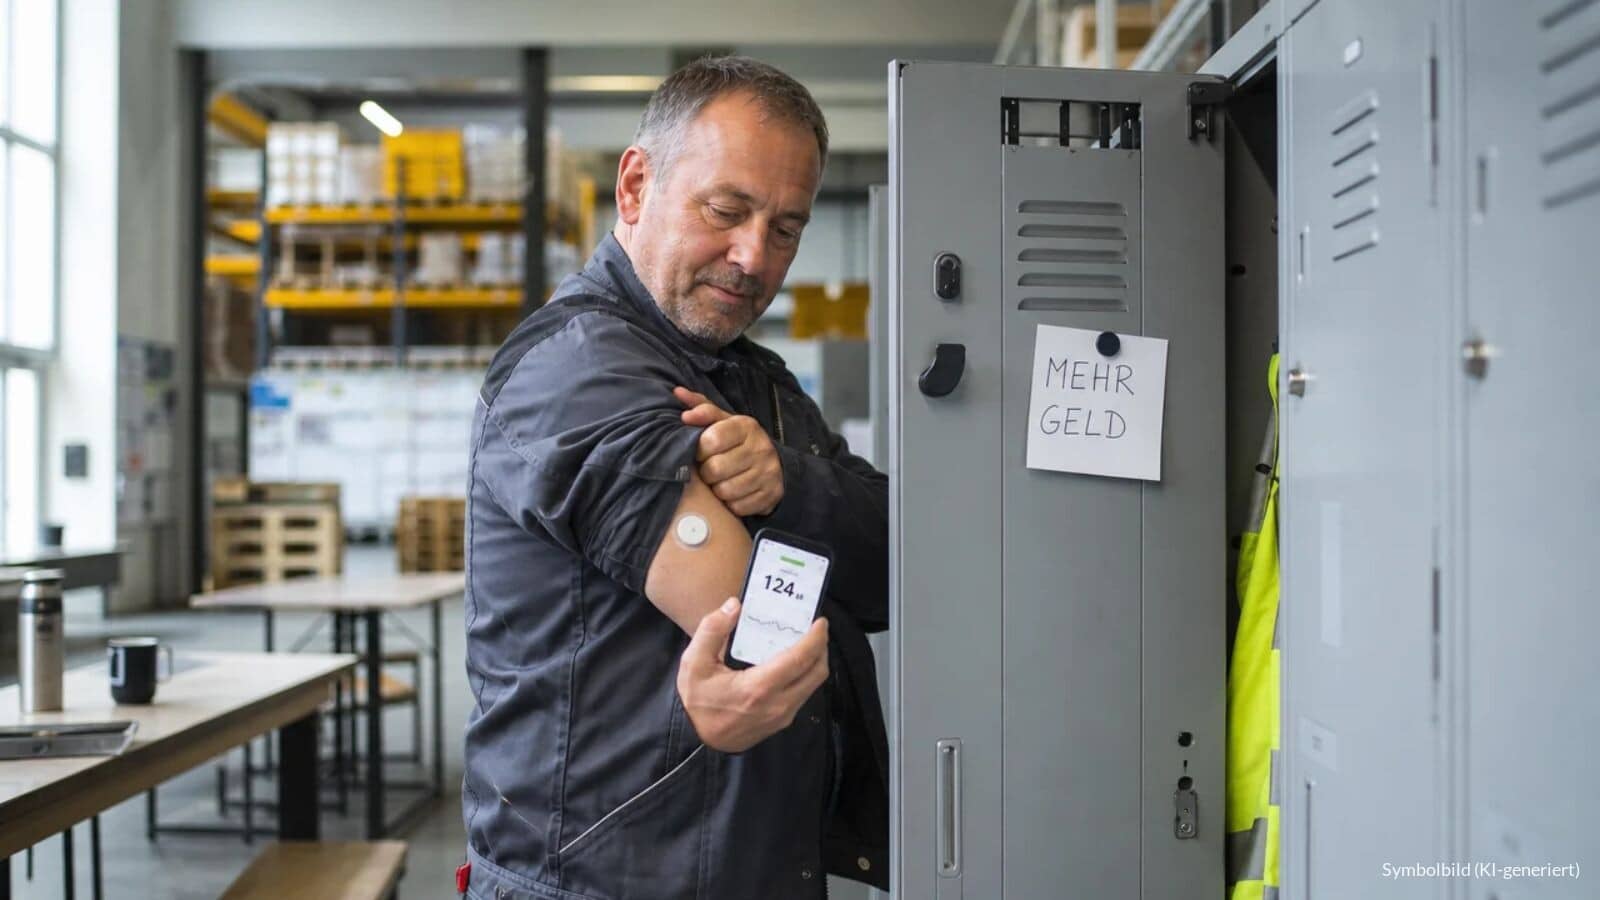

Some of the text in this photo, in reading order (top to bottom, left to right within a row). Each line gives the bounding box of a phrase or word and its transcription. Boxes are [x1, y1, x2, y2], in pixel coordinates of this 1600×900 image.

[1045, 356, 1135, 396] MEHR
[1039, 404, 1127, 440] GELD
[764, 575, 796, 598] 124
